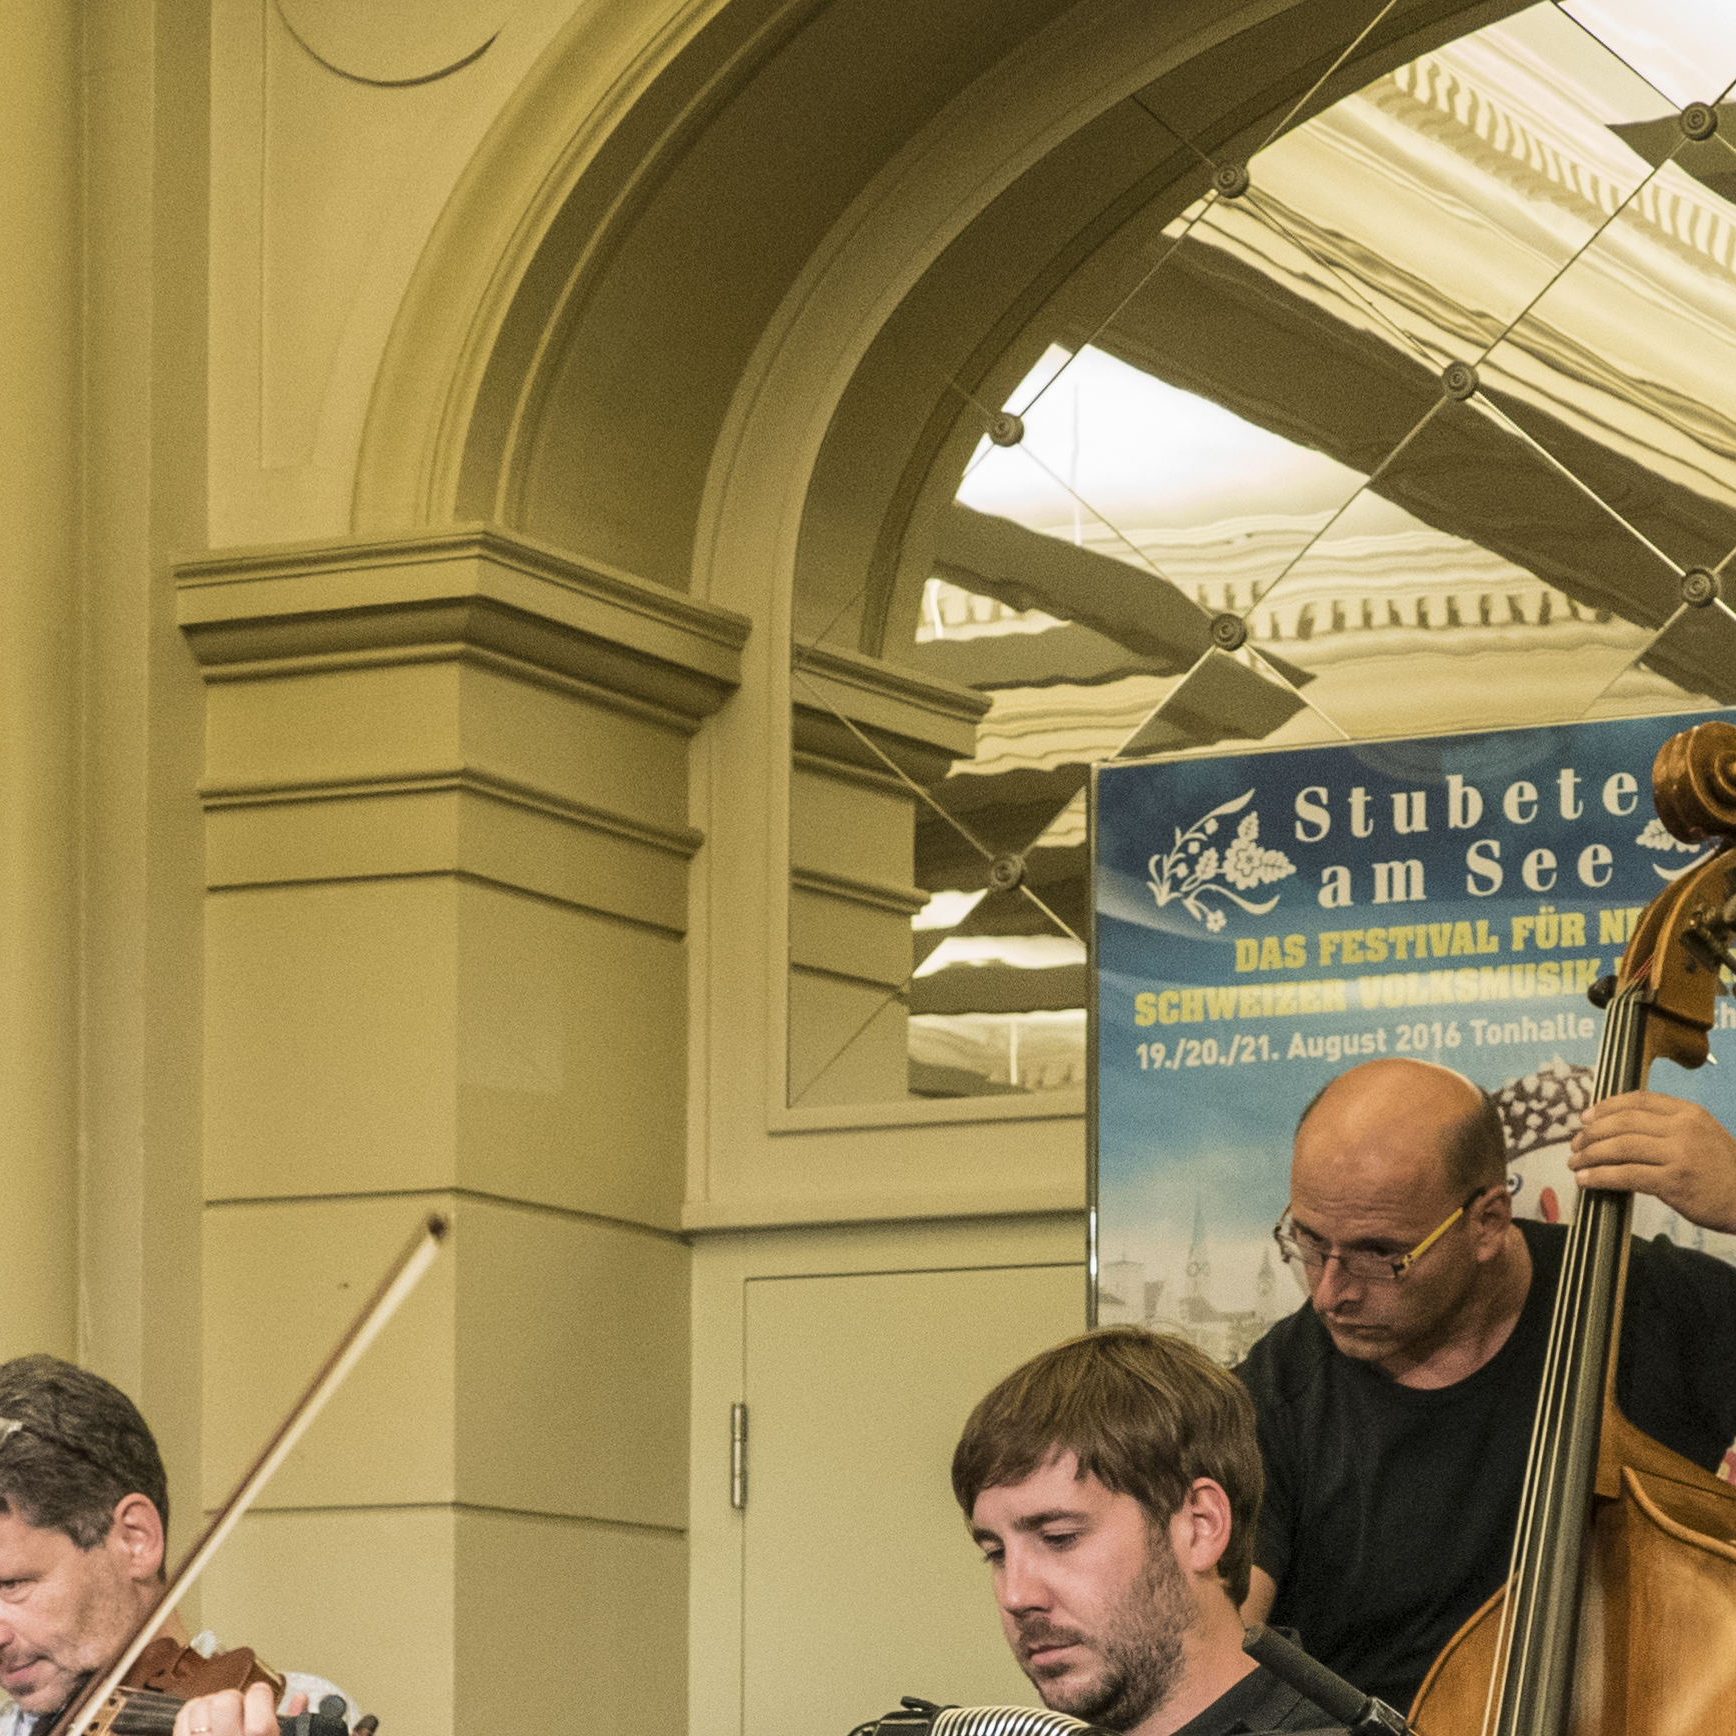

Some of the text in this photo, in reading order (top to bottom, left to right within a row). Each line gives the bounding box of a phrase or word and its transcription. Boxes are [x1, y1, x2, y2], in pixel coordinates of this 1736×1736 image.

[1294, 768, 1639, 843] Stubete
[1318, 839, 1614, 909] am See
[1234, 933, 1307, 973] DAS
[1318, 919, 1500, 967] FESTIVAL
[1511, 905, 1587, 951] FÜR
[1134, 979, 1347, 1027] SCHWEIZER
[1358, 958, 1601, 1010] VOLKSMUSIK
[1136, 1033, 1279, 1070] 19./20./21.
[1287, 1028, 1387, 1063] August
[1395, 1021, 1462, 1053] 2016
[1470, 1012, 1596, 1047] Tonhalle
